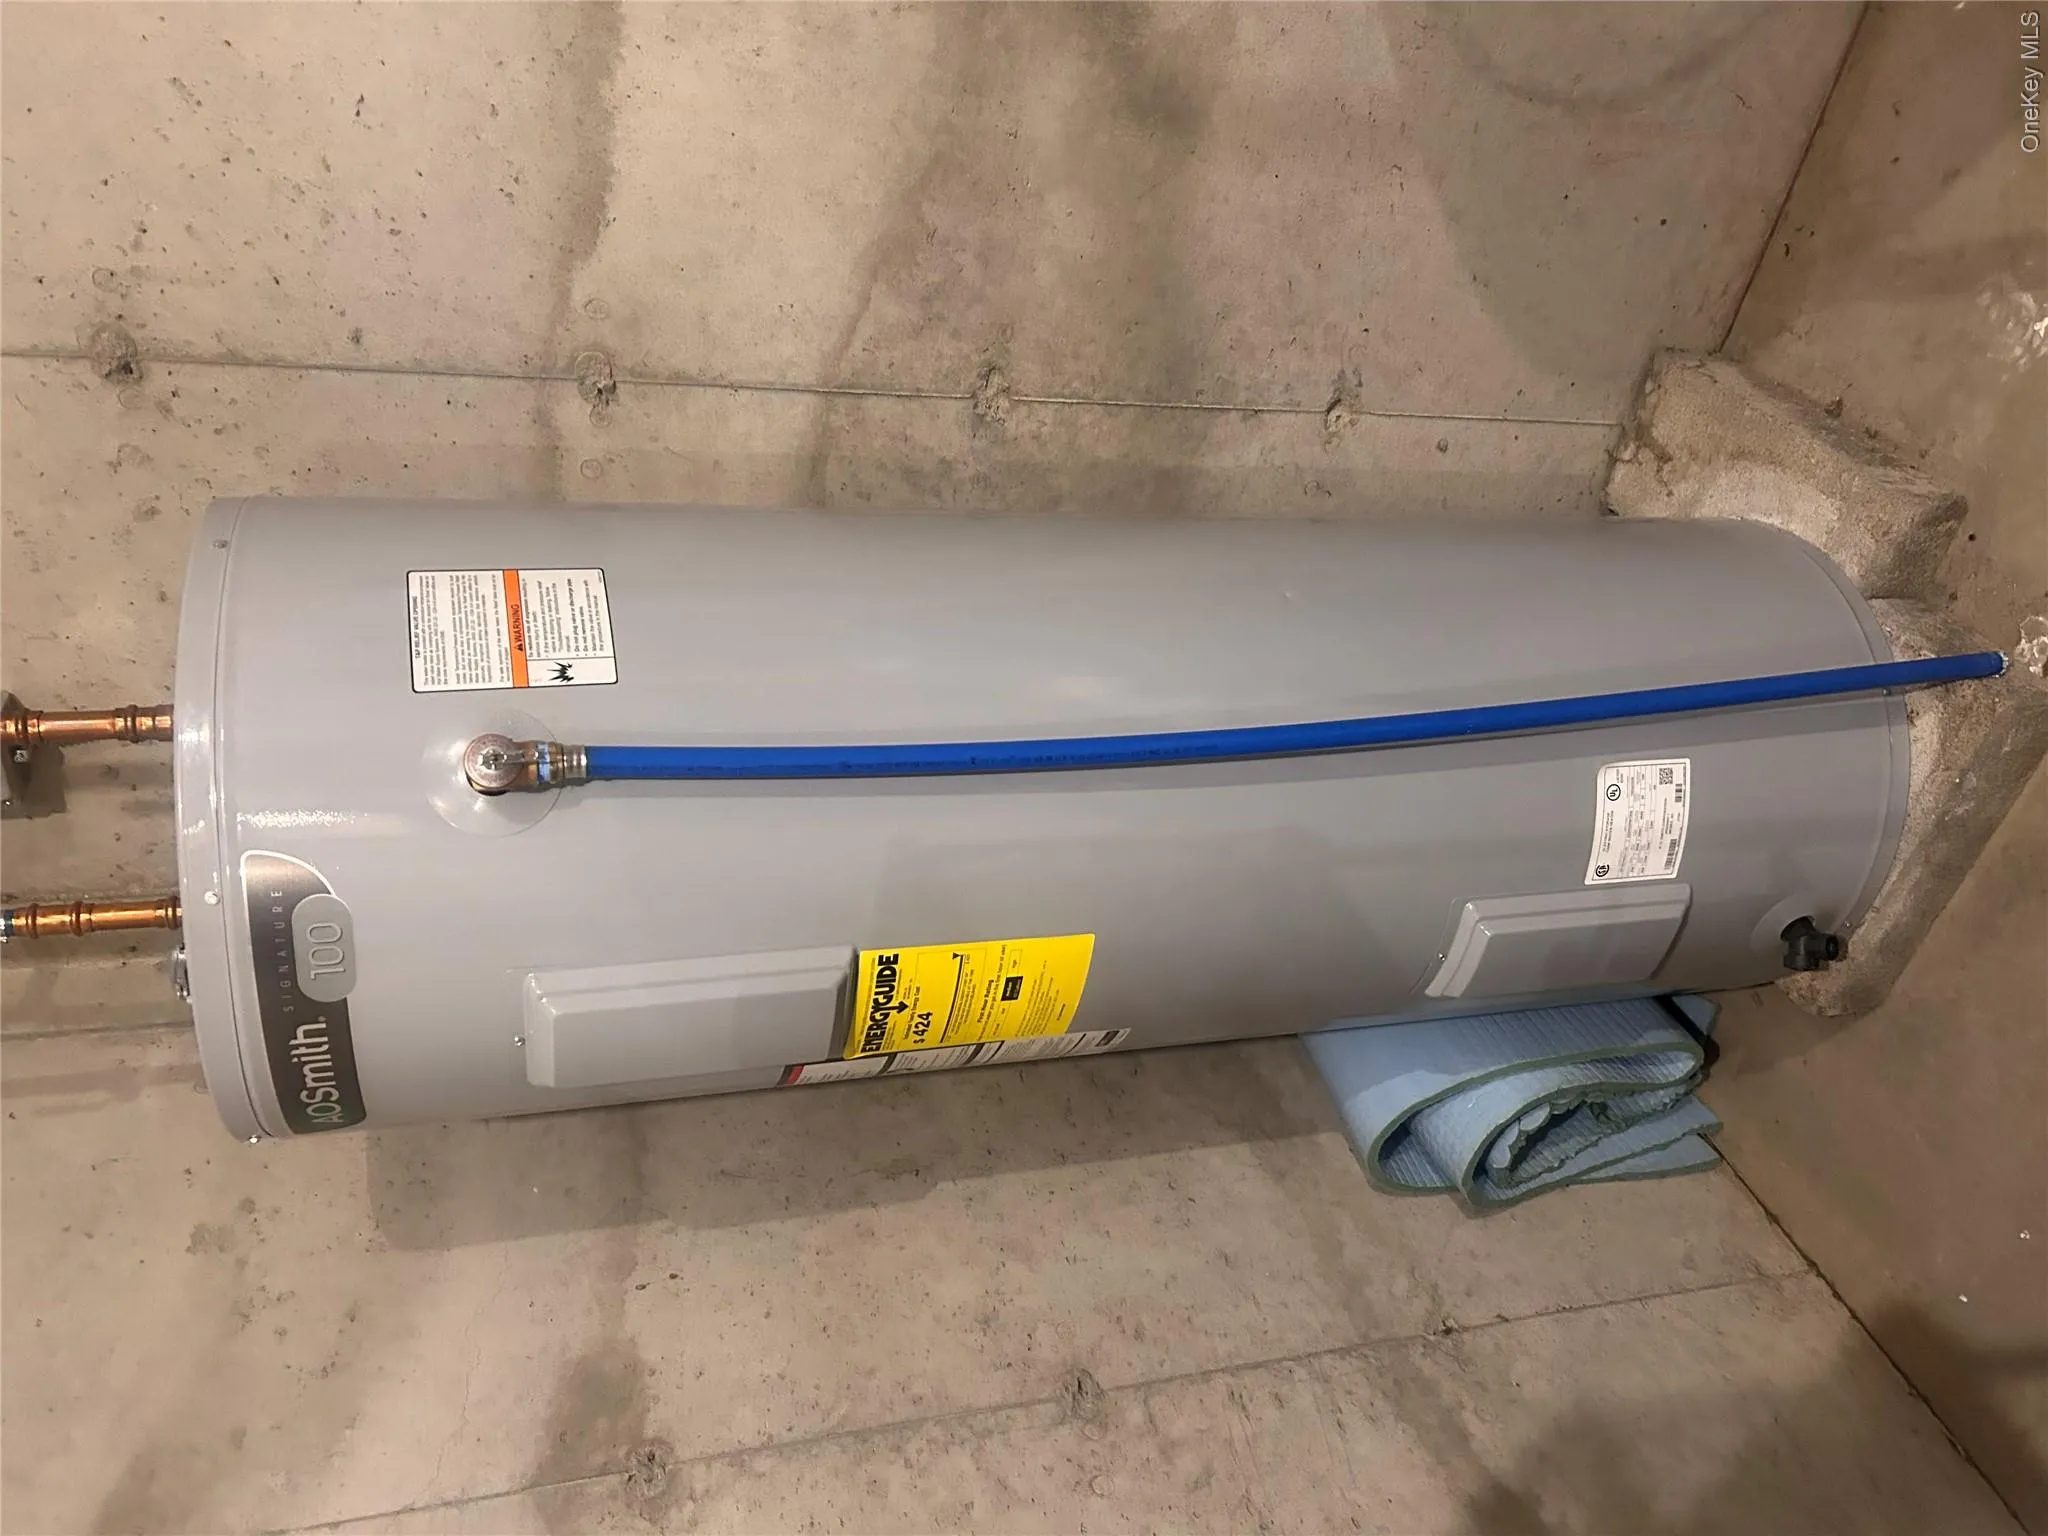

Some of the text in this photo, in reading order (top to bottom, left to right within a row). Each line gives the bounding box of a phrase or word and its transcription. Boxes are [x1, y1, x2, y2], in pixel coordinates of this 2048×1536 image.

[511, 604, 522, 643] WARNING
[270, 890, 294, 1013] SIGNATURE
[306, 923, 345, 979] 100
[861, 953, 899, 1053] ENERGYGUIDE
[912, 1012, 933, 1036] 424
